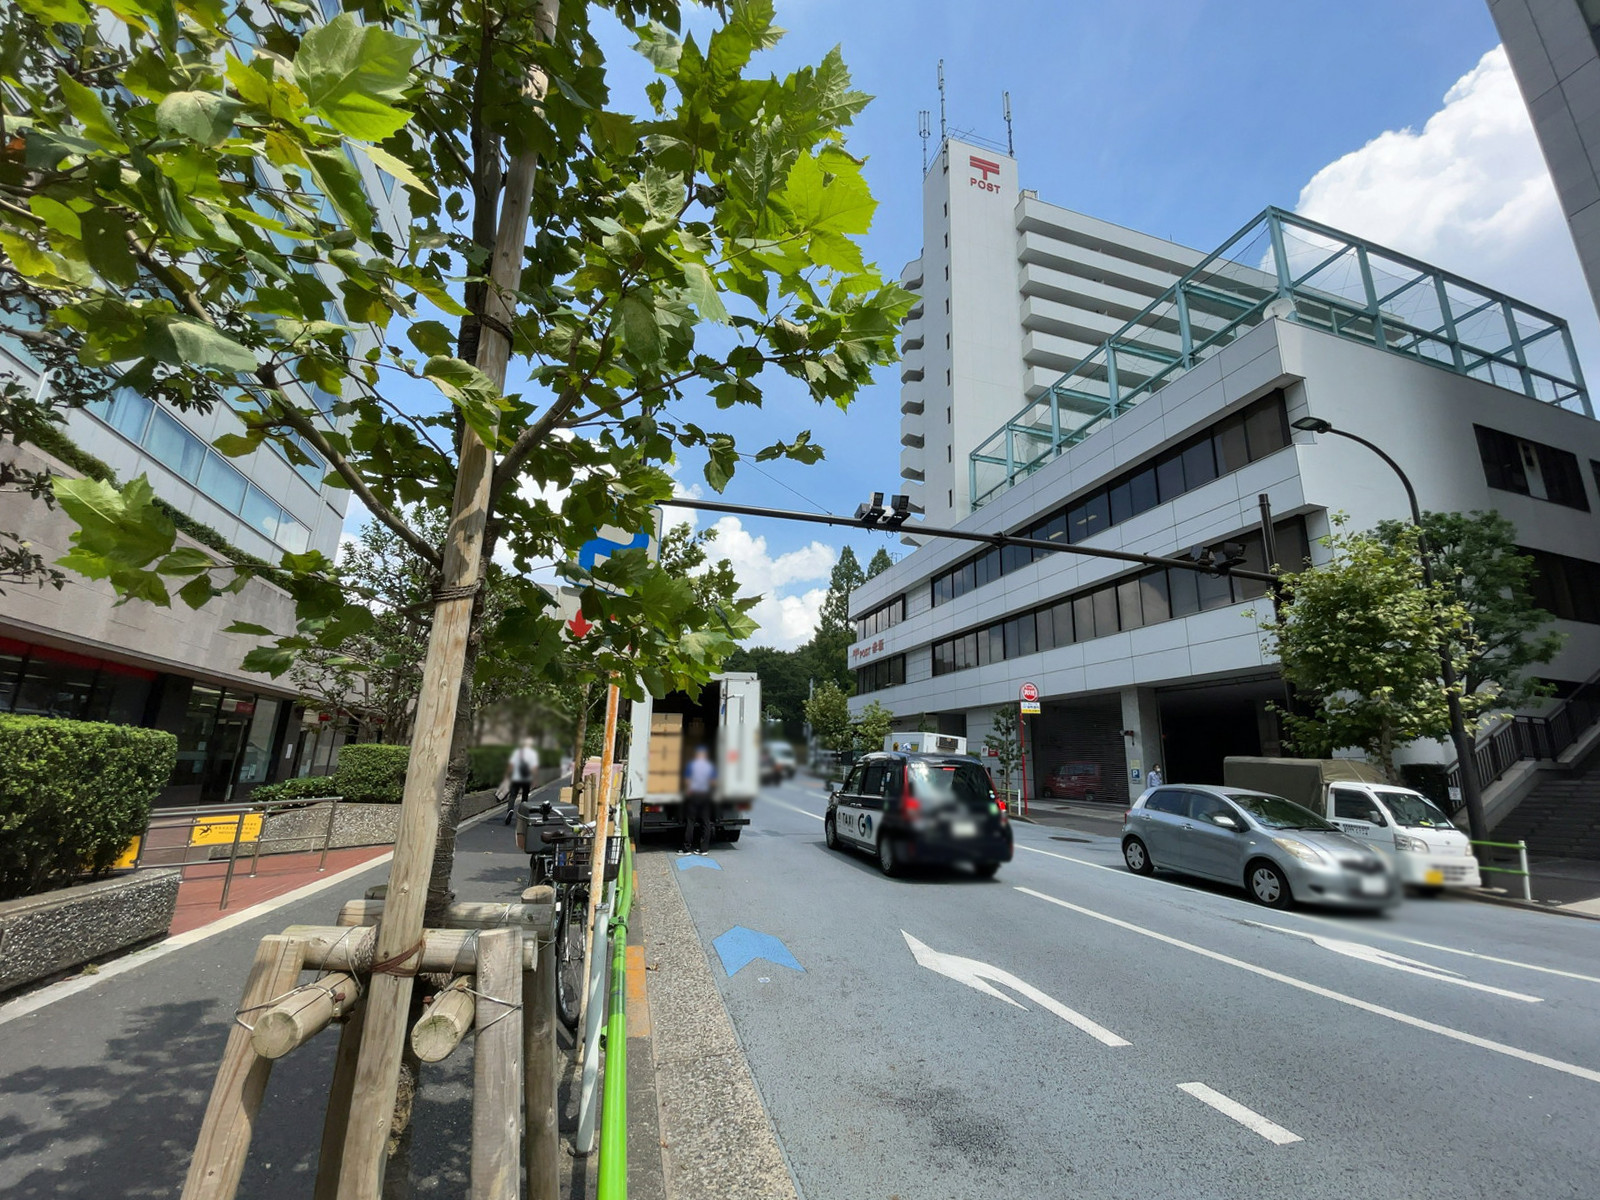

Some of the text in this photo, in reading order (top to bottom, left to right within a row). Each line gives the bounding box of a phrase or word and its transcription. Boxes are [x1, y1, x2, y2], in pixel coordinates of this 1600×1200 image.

[970, 177, 1001, 194] POST
[842, 812, 854, 828] TAXI
[858, 813, 872, 839] GO
